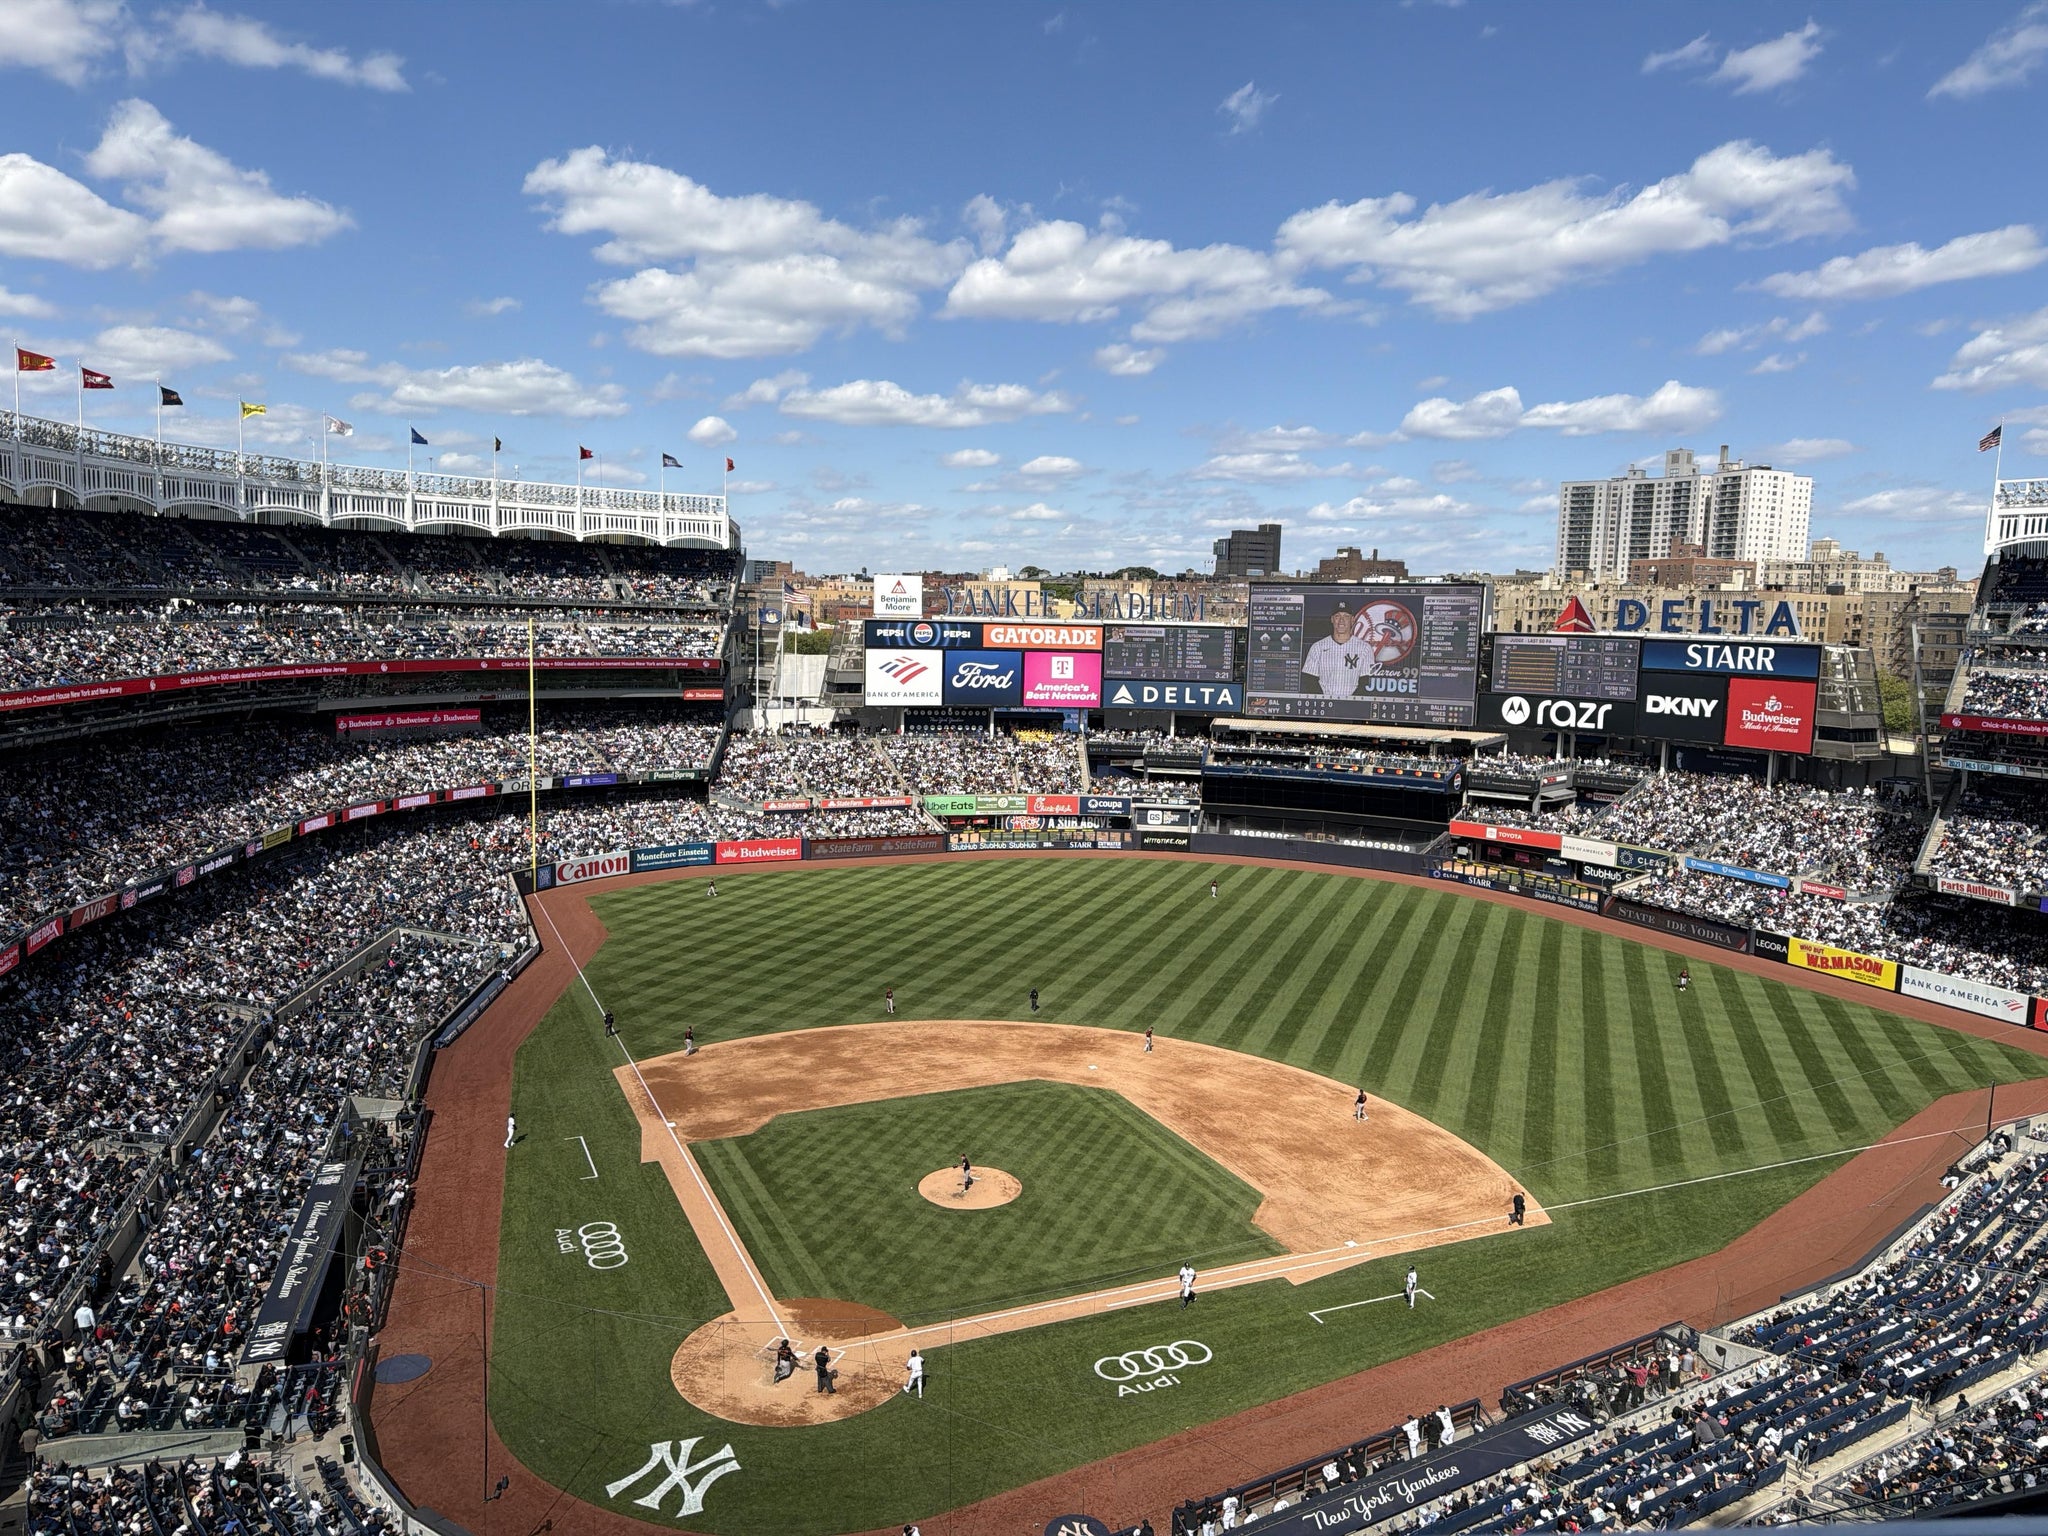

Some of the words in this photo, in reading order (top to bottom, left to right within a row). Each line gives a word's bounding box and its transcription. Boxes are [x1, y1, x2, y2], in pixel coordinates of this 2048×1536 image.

[881, 595, 917, 605] Benjamin
[940, 586, 1056, 618] YANKEE
[1073, 590, 1206, 622] STADIUM
[1616, 599, 1802, 635] DELTA
[876, 629, 904, 637] PEPSI
[944, 630, 971, 638] PEPSI
[990, 626, 1098, 646] GATORADE
[1685, 644, 1776, 672] STARR
[241, 672, 257, 680] donated
[262, 670, 281, 678] Covenant
[332, 666, 348, 674] Jersey
[952, 662, 1014, 689] Ford
[1368, 662, 1402, 678] Aaron
[1402, 667, 1418, 678] 99
[1035, 683, 1090, 692] America's
[1365, 678, 1418, 694] JUDGE
[5, 696, 26, 707] donated
[33, 692, 55, 704] Covenant
[56, 692, 70, 700] House
[70, 690, 80, 698] New
[81, 690, 90, 698] York
[109, 686, 122, 695] Jersey
[1026, 691, 1050, 700] Best
[1052, 692, 1098, 701] Network
[1143, 686, 1234, 706] DELTA
[1646, 694, 1718, 718] DKNY
[348, 720, 382, 728] Budweiser
[396, 716, 430, 725] Budweiser
[443, 713, 478, 722] Budweiser
[1536, 700, 1613, 730] razr
[1742, 710, 1802, 726] Budweiser
[1740, 721, 1762, 730] Made
[1770, 724, 1799, 734] America
[1982, 721, 2016, 730] Chick-fil-A
[2018, 724, 2041, 732] Double
[1965, 762, 1977, 770] MLS
[1980, 764, 1992, 772] CUP
[653, 770, 674, 780] Poland
[674, 770, 695, 780] Spring
[511, 779, 542, 792] ORS
[926, 801, 950, 811] Uber
[950, 801, 974, 811] Eats
[1098, 799, 1123, 810] coupa
[1048, 818, 1056, 829] A
[1080, 816, 1112, 829] ABOVE
[1150, 814, 1161, 822] GS
[1143, 836, 1188, 846] NITTOTIRE.COM
[1498, 832, 1522, 840] TOYOTA
[951, 842, 978, 852] StubHub
[980, 842, 1008, 850] StubHub
[1008, 841, 1037, 850] StubHub
[1586, 848, 1605, 856] AMERICA
[636, 850, 677, 862] Montefiore
[678, 848, 710, 857] Einstein
[740, 846, 798, 859] Budweiser
[204, 862, 214, 873] sub
[215, 854, 233, 868] above
[556, 854, 628, 882] Canon
[1546, 858, 1568, 866] ARENA
[1637, 856, 1666, 868] CLEAR
[1442, 872, 1460, 880] CLEAR
[1584, 866, 1622, 882] StubHub
[1468, 876, 1492, 888] STARR
[152, 884, 163, 894] above
[1534, 890, 1556, 901] StubHub
[1802, 884, 1828, 894] Reebok
[1940, 880, 1966, 892] Parts
[1966, 884, 2010, 901] Authority
[1557, 895, 1578, 907] StubHub
[1578, 900, 1598, 912] StubHub
[80, 900, 108, 923] AVIS
[1618, 906, 1656, 924] STATE
[1690, 924, 1732, 944] VODKA
[30, 931, 43, 948] TIRE
[1756, 938, 1788, 954] LEGORA
[1806, 953, 1884, 976] W.B.MASON
[1904, 977, 1932, 991] BANK
[1934, 984, 1948, 994] OF
[1950, 988, 2000, 1008] AMERICA
[554, 1228, 579, 1254] Audi
[278, 1266, 308, 1299] Stadium
[1118, 1374, 1182, 1398] Audi
[1524, 1422, 1547, 1435] NEW
[1528, 1426, 1559, 1441] YORK
[1539, 1434, 1564, 1446] LIFE
[605, 1436, 742, 1518] NY
[1302, 1508, 1350, 1530] New
[1344, 1486, 1394, 1522] York
[1389, 1462, 1460, 1505] Yankees
